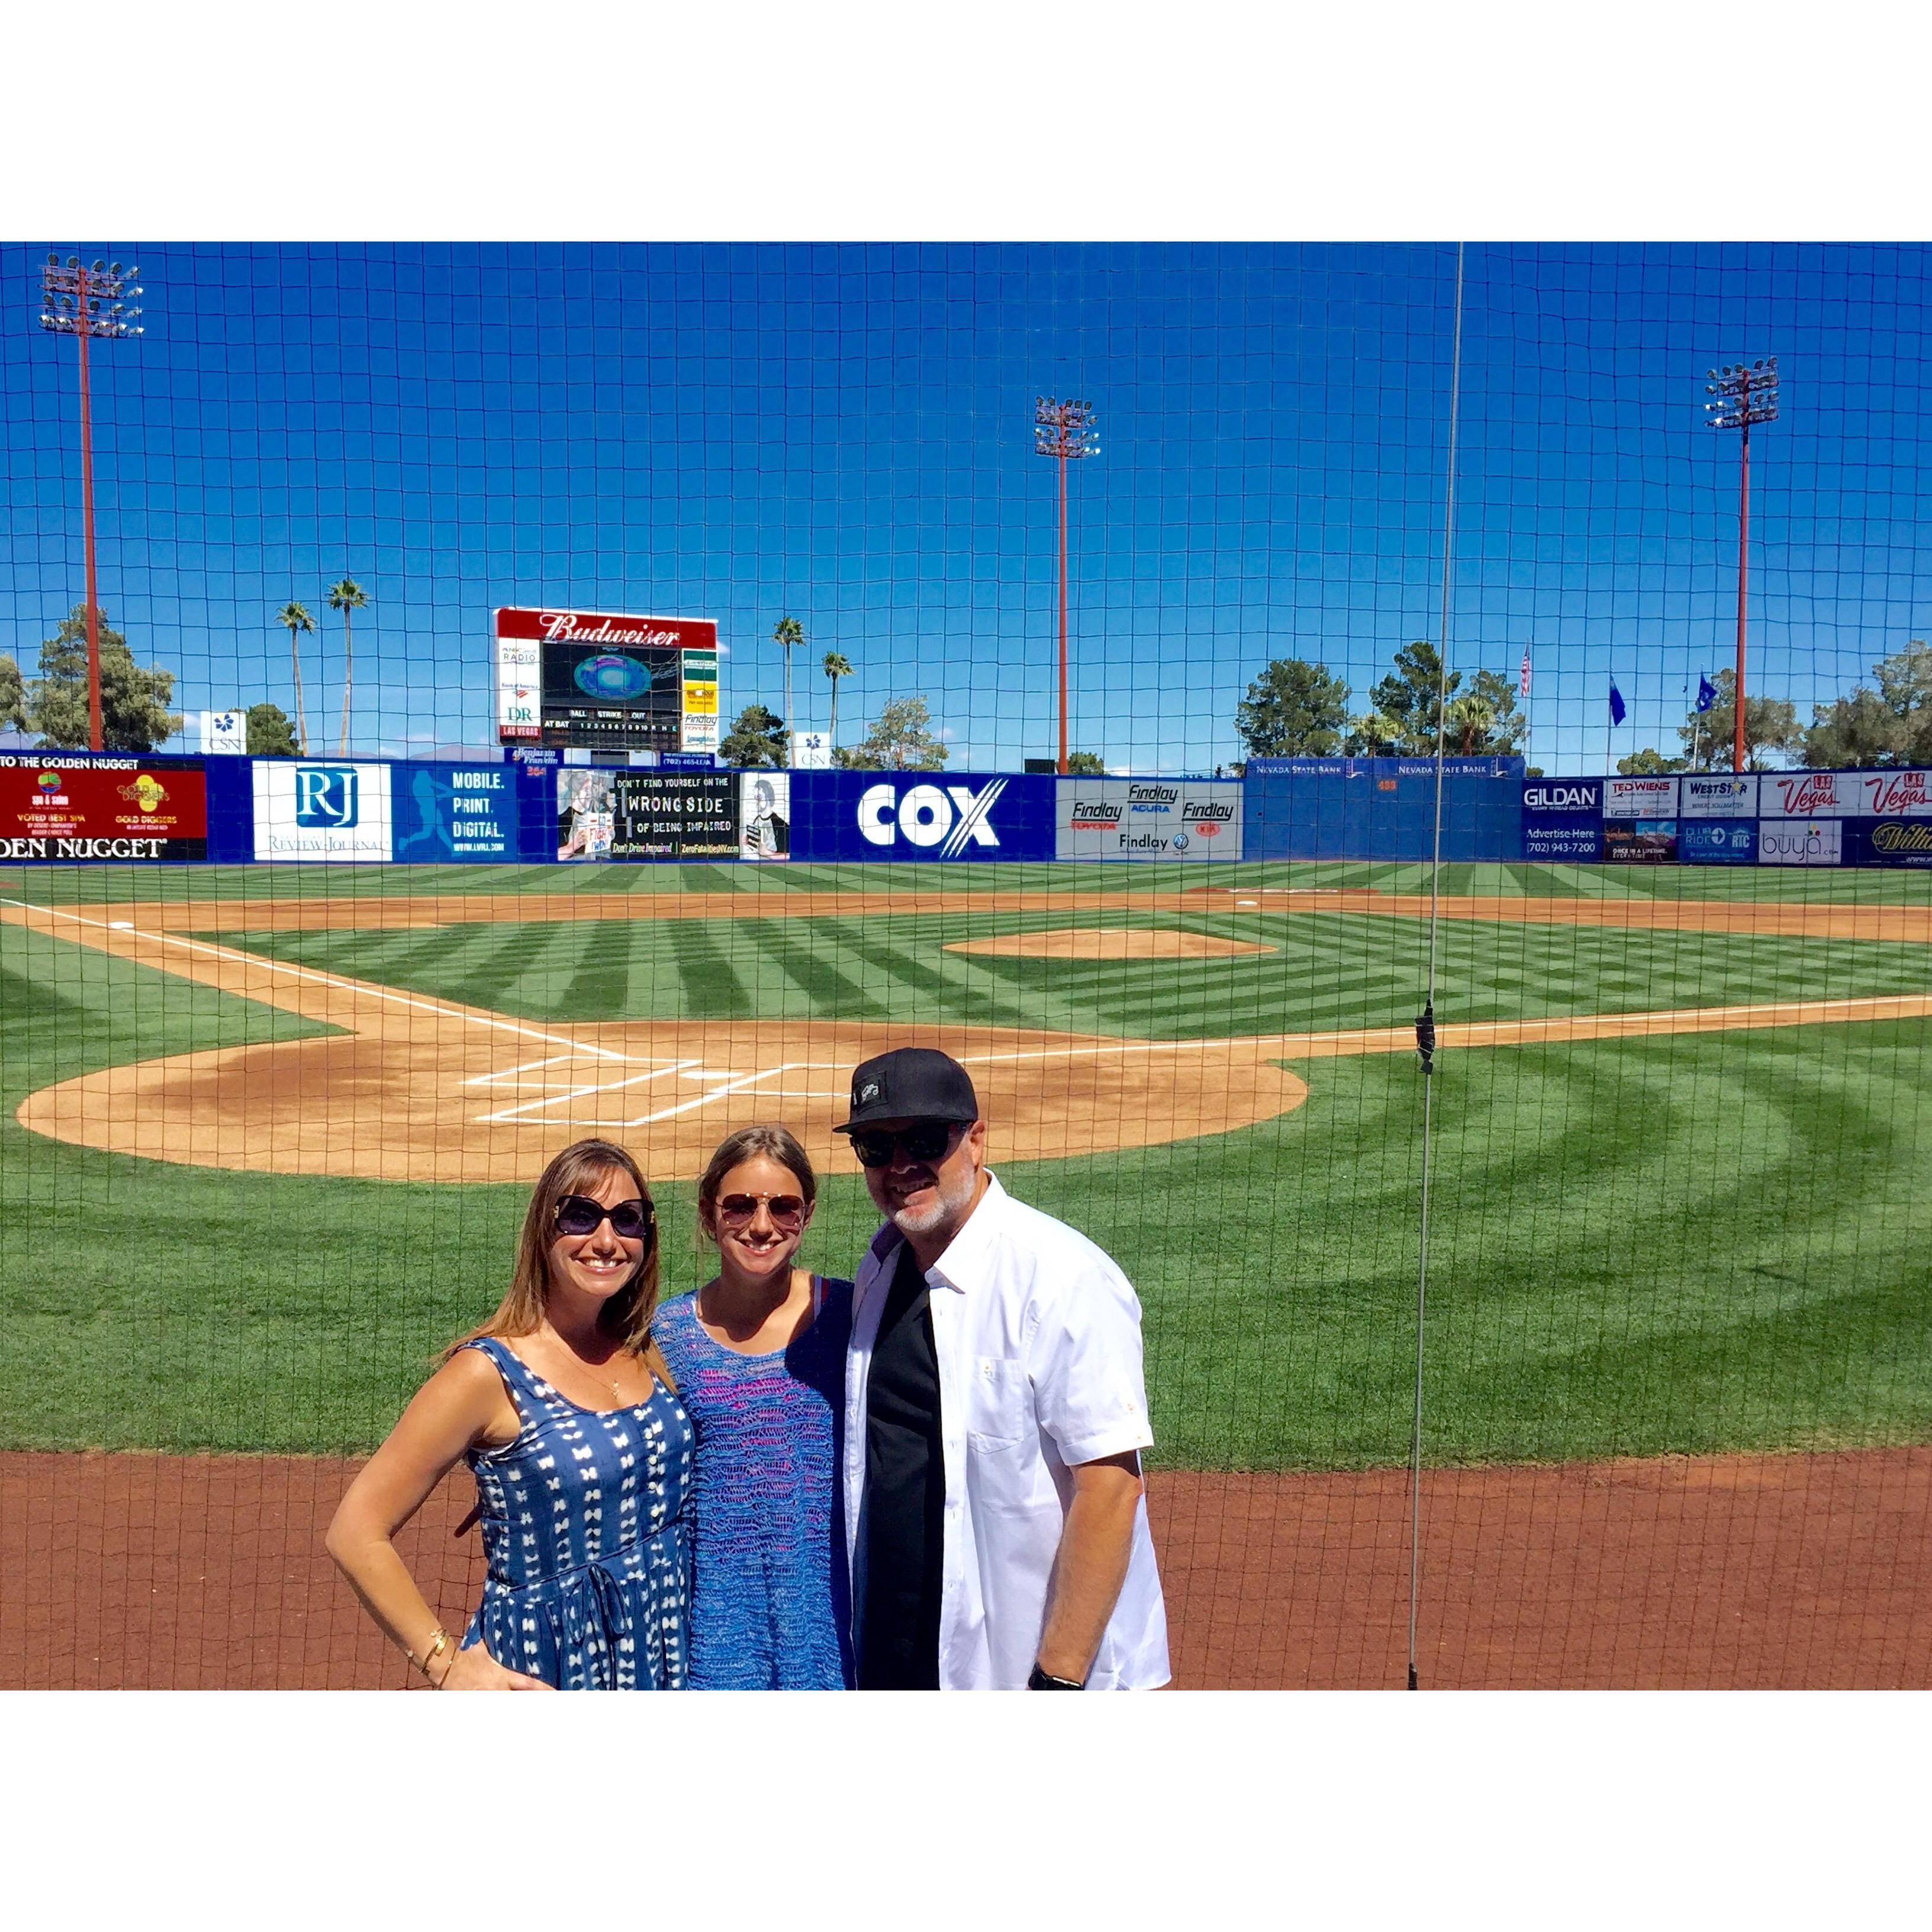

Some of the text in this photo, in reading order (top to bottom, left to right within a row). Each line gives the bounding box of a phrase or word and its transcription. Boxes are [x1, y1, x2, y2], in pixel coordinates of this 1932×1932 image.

[540, 614, 680, 646] Budweiser
[507, 707, 533, 722] DR
[685, 714, 717, 726] Findlay
[517, 727, 538, 736] VEGAS
[210, 738, 240, 751] CSN
[0, 756, 139, 770] TO THE GOLDEN NUGGET
[523, 756, 558, 764] Franklin
[801, 754, 825, 766] CSN
[1256, 765, 1341, 774] NEVADA STATE BANK
[1399, 766, 1433, 774] NEVADA
[1463, 765, 1486, 774] BANK
[453, 772, 504, 788] MOBILE.
[617, 777, 728, 788] DON'T FIND YOURSELF ON THE
[1815, 776, 1832, 789] LAS
[1905, 773, 1924, 787] LAS
[1612, 781, 1670, 794] TED WIENS
[297, 771, 358, 826] RJ
[1129, 785, 1178, 804] Findlay
[1524, 787, 1596, 806] GILDAN
[1778, 777, 1840, 816] Vegas
[1866, 776, 1932, 815] Vegas
[453, 797, 493, 813] PRINT.
[629, 796, 723, 813] WRONG SIDE
[1131, 804, 1170, 813] ACURA
[17, 813, 85, 823] VOTED BEST SPA
[858, 777, 1009, 858] COX
[1072, 802, 1122, 822] Findlay
[1183, 802, 1234, 821] Findlay
[141, 816, 178, 824] DIGGERS
[1070, 822, 1117, 830] TOYOTA
[453, 822, 504, 838] DIGITAL.
[637, 821, 732, 833] OF BEING IMPAIRED
[1527, 828, 1595, 838] Advertise Here
[56, 838, 160, 858] NUGGET
[1120, 833, 1168, 851] Findlay
[1527, 842, 1596, 854] (702) 943-7200
[1732, 835, 1750, 848] RTC
